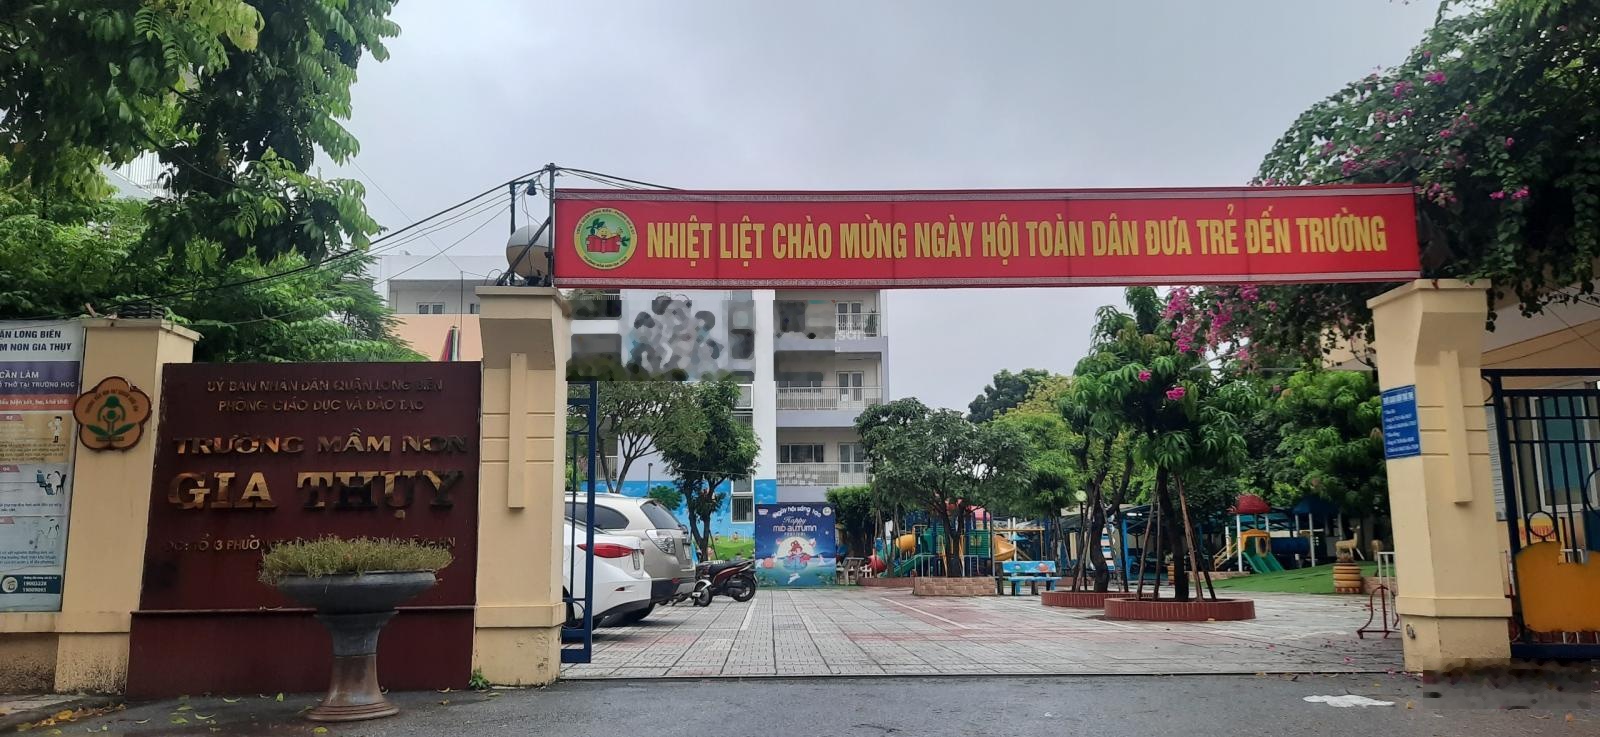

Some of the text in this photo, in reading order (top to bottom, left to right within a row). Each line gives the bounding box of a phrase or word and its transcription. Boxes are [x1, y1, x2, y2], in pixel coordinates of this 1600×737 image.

[647, 215, 713, 267] NHIỆT
[720, 215, 765, 267] LIỆT
[772, 215, 832, 259] CHÀO
[839, 213, 907, 259] MỪNG
[914, 214, 974, 258] NGÀY
[981, 213, 1019, 266] HỘI
[1026, 213, 1085, 257] TOÀN
[1091, 213, 1139, 256] DÂN
[1145, 215, 1192, 256] ĐƯA
[1196, 203, 1240, 255] TRẺ
[1244, 205, 1292, 254] ĐẾN
[1295, 206, 1387, 253] TRƯỜNG
[14, 330, 37, 338] LONG
[40, 329, 61, 338] BIÊN
[10, 343, 29, 351] NON
[32, 343, 47, 351] GIA
[50, 342, 72, 352] THỤY
[229, 380, 257, 392] BAN
[260, 377, 298, 391] NHÂN
[301, 377, 329, 391] DÂN
[376, 379, 410, 391] LONG
[272, 396, 308, 411] GIÁO
[313, 399, 340, 414] DỤC
[174, 427, 468, 454] TRƯỜNG MẦM NON
[168, 470, 463, 520] GIA THỤY
